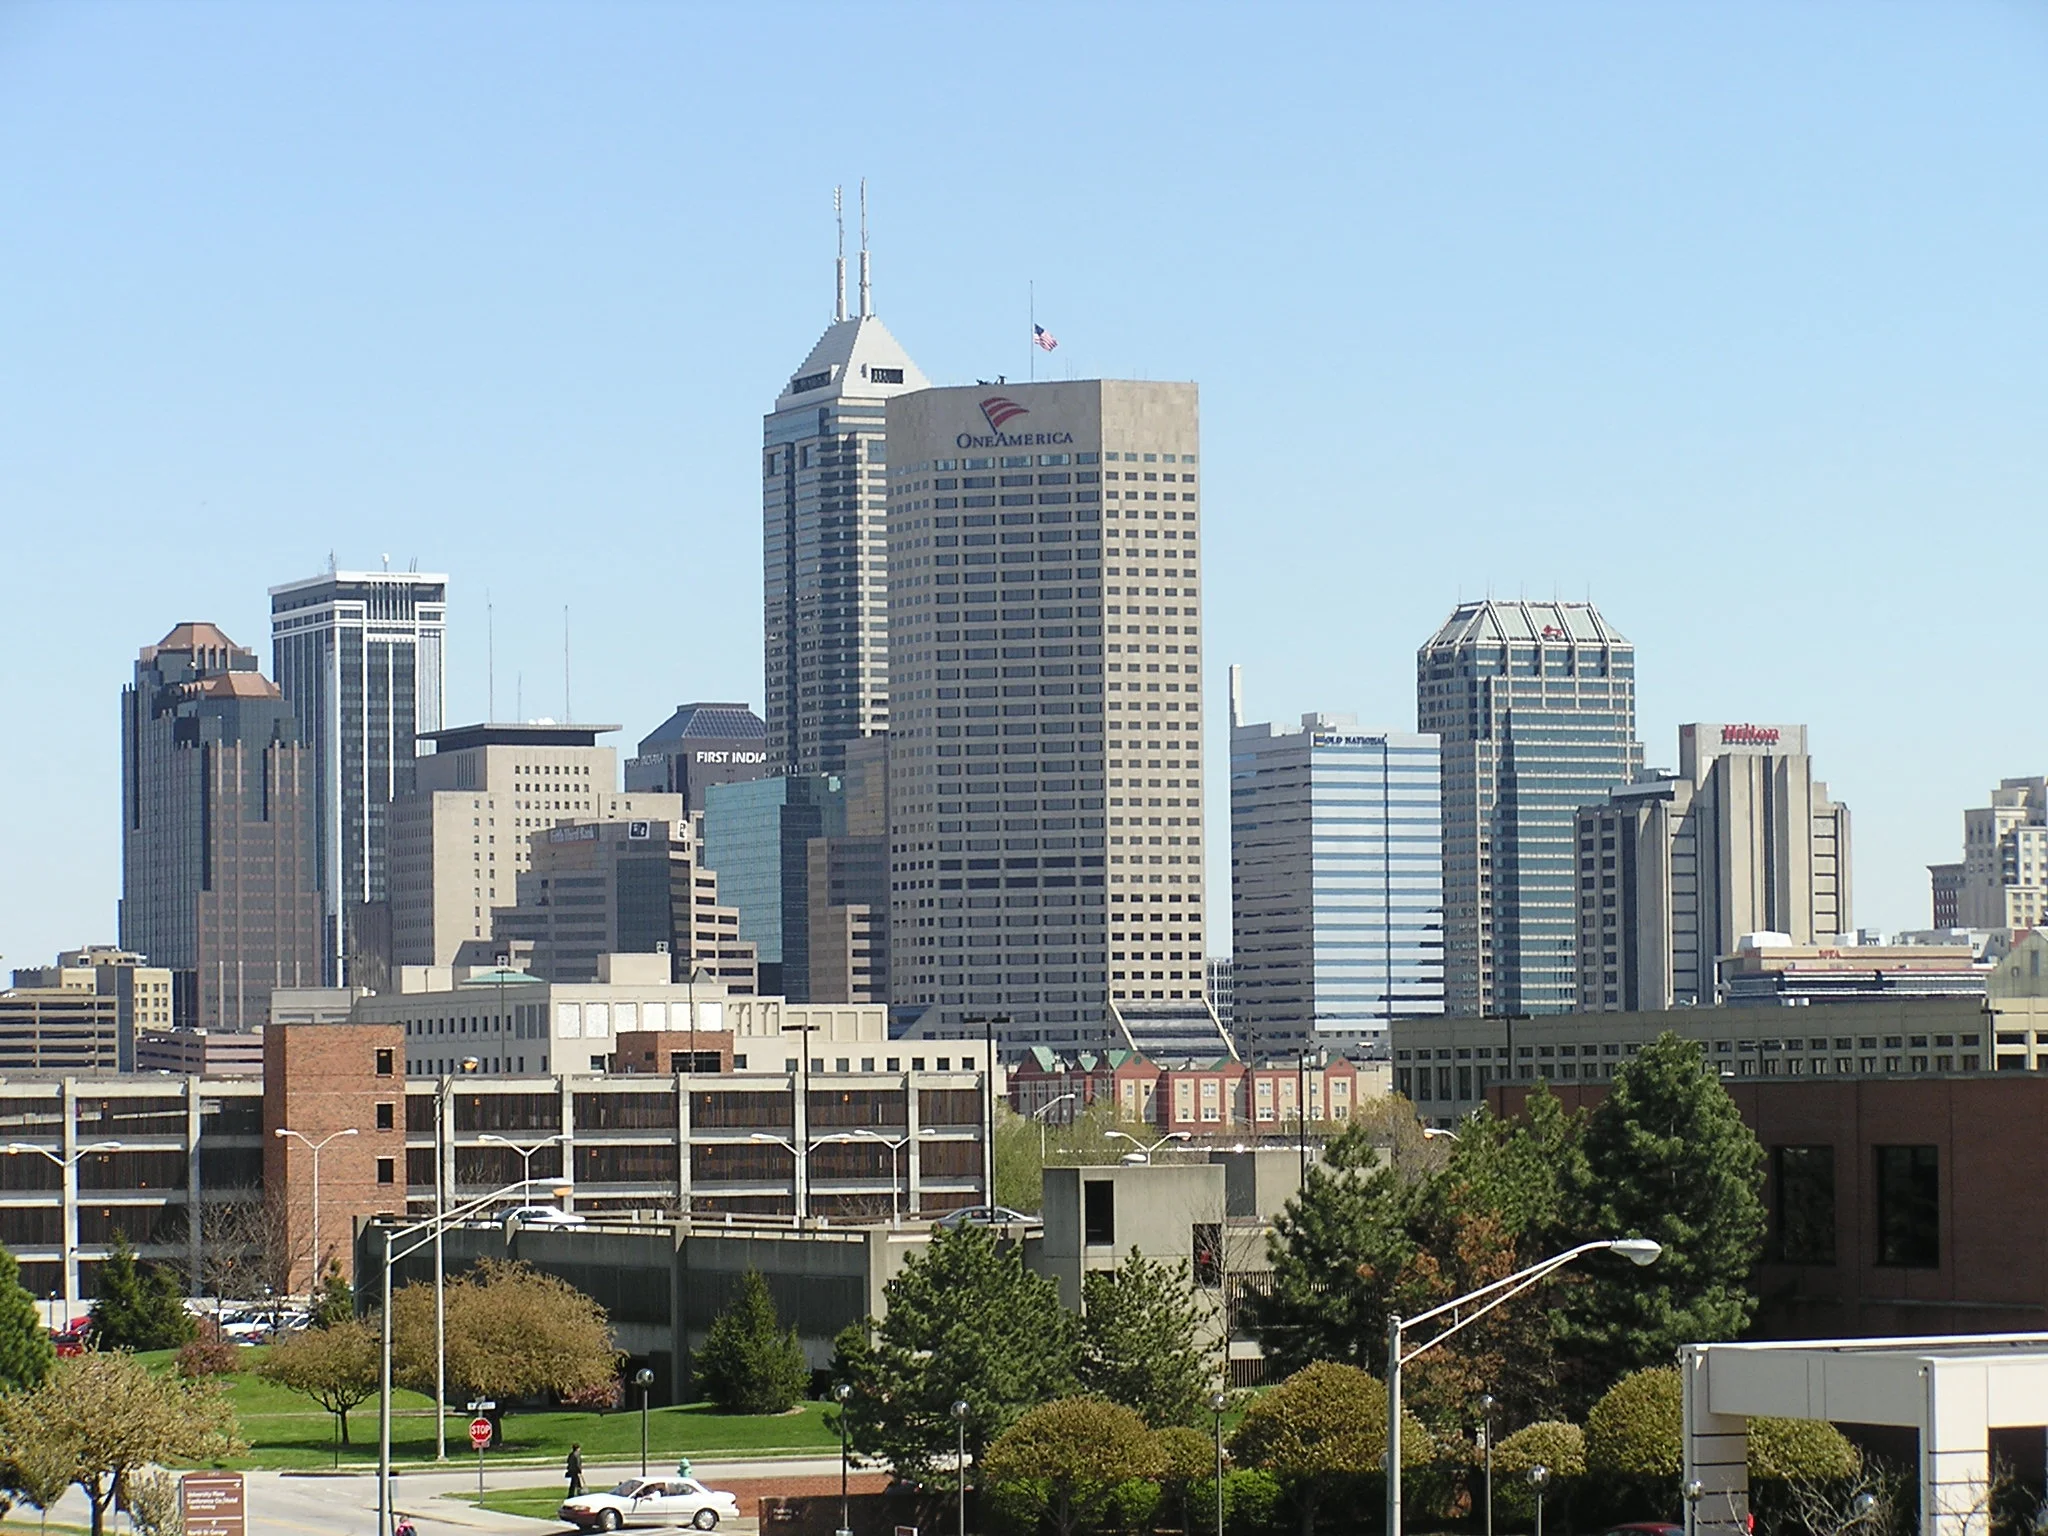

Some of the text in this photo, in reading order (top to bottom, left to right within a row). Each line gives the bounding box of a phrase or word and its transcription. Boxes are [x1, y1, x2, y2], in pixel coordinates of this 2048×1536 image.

[956, 432, 1073, 449] ONEAMERICA
[1722, 723, 1779, 742] Hilton
[1325, 736, 1343, 745] OLD
[696, 751, 767, 764] FIRST INDIA
[471, 1425, 491, 1435] STOP
